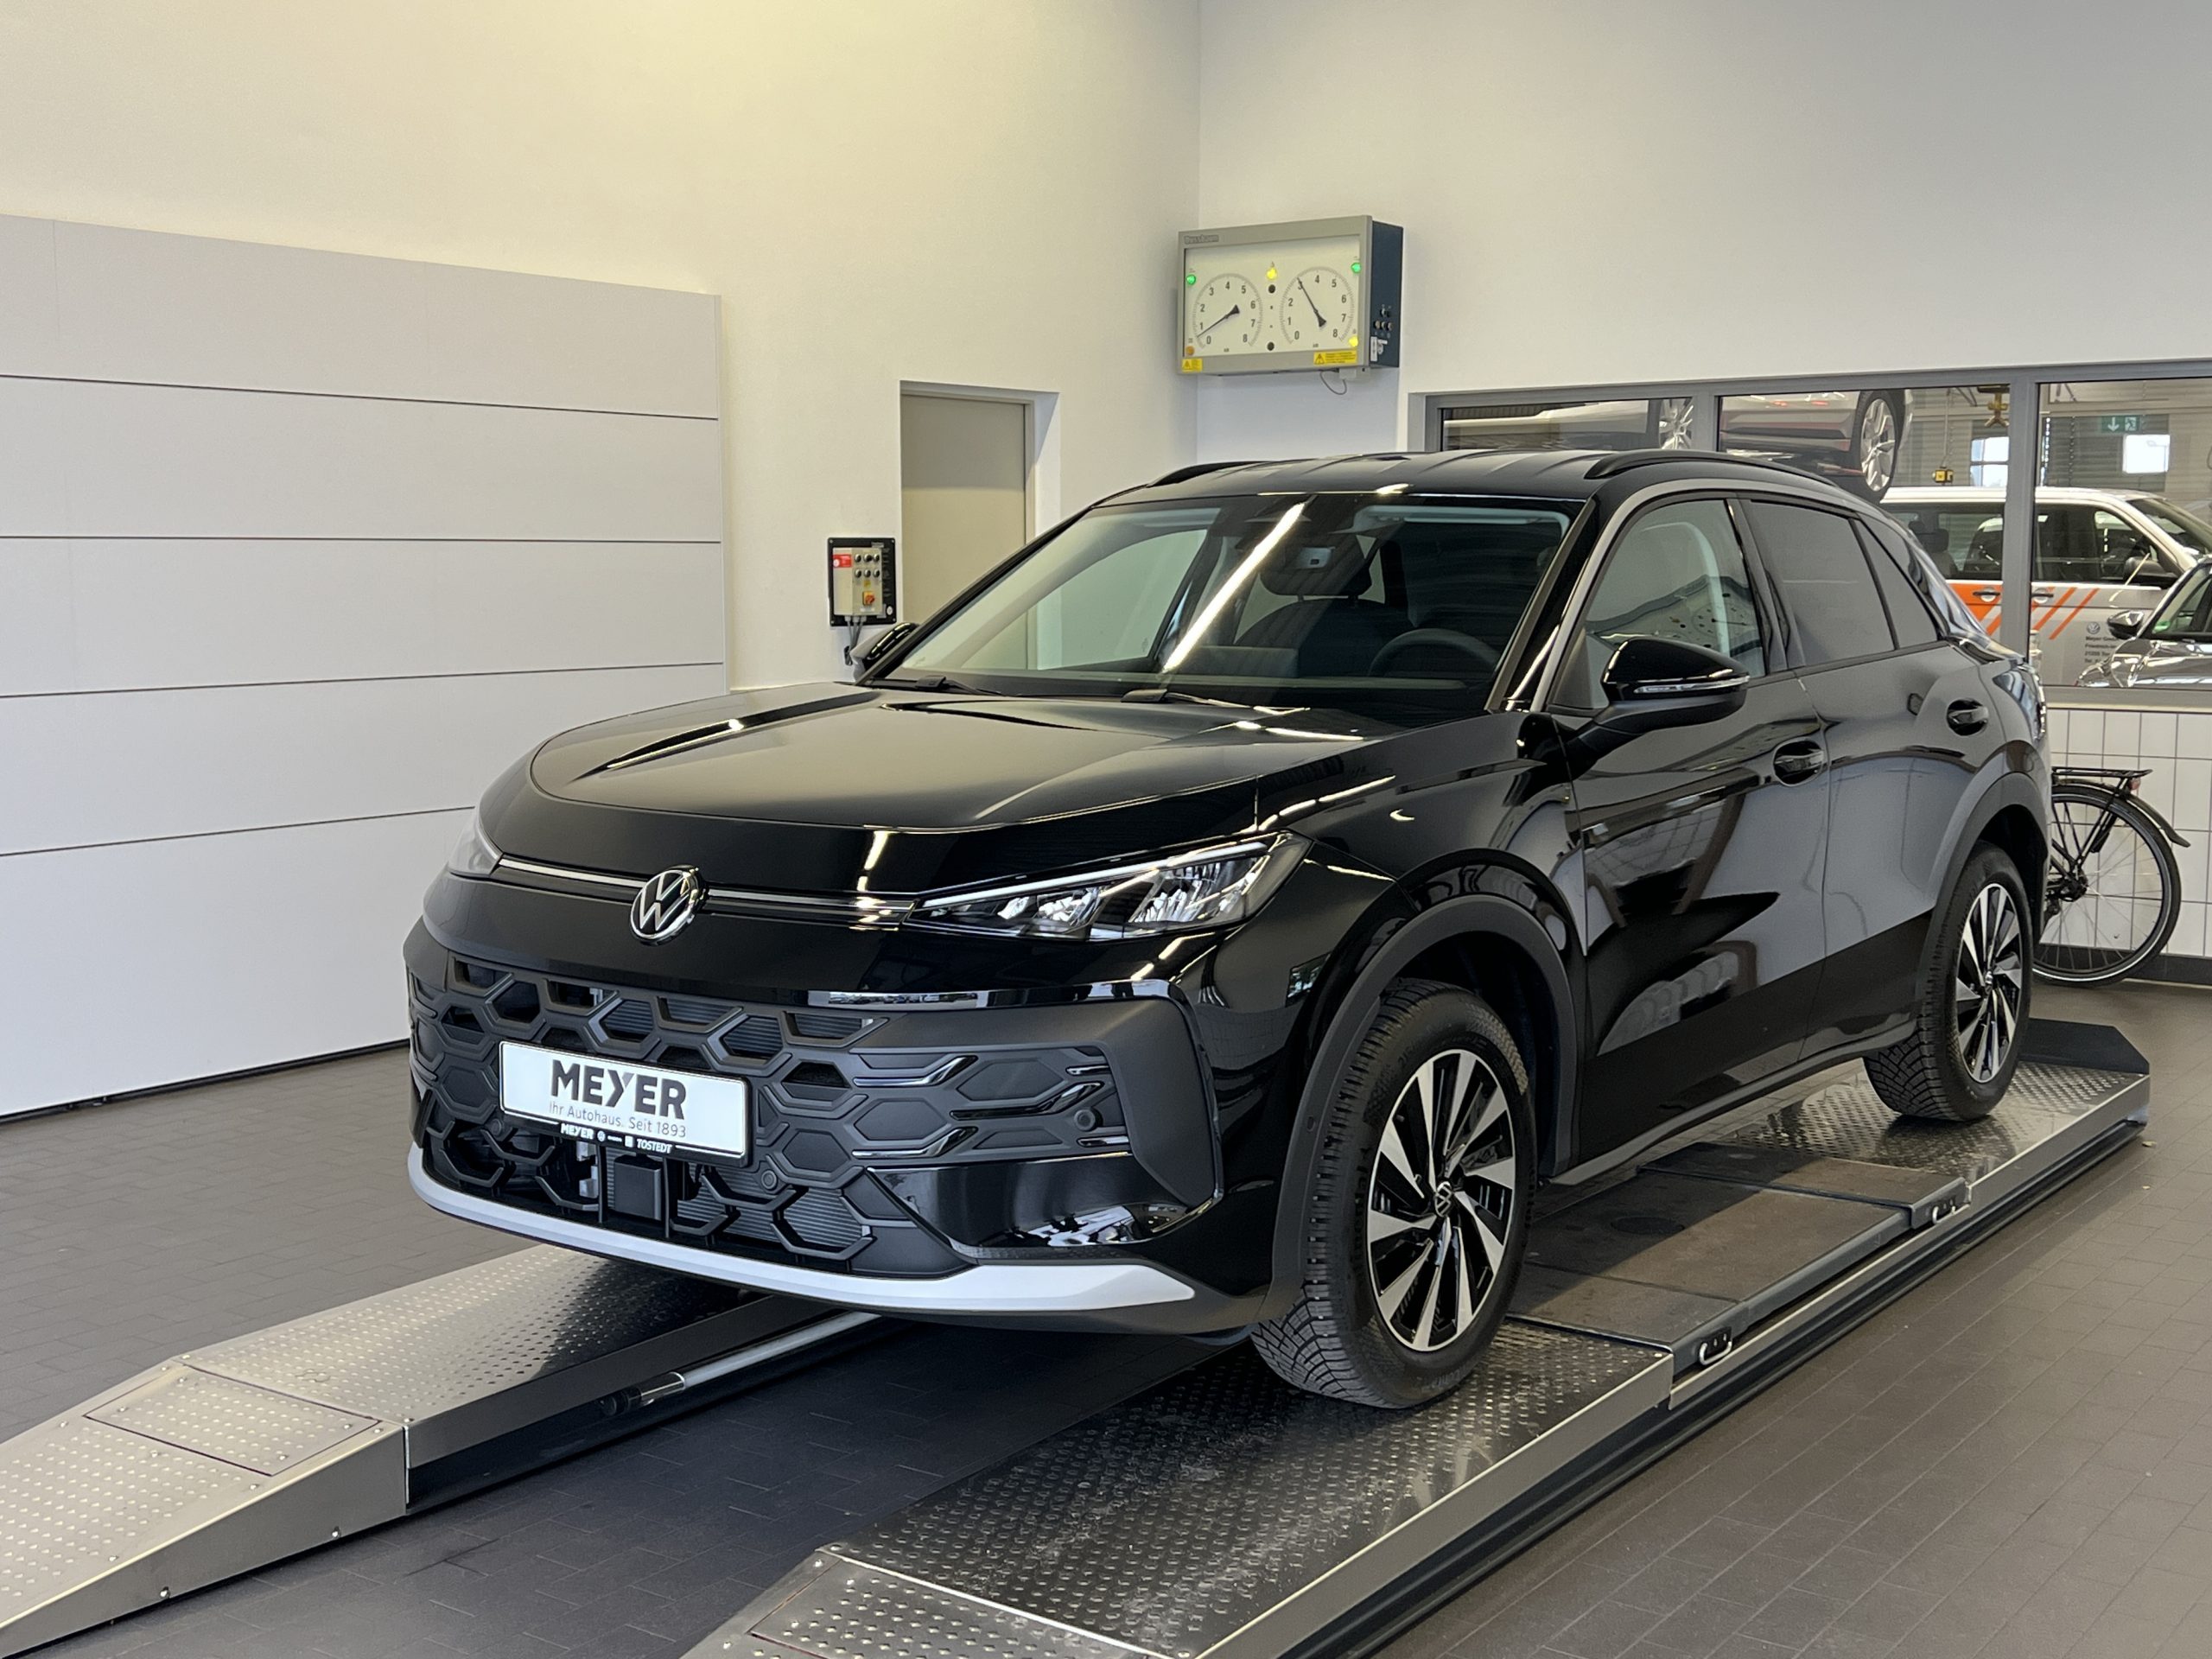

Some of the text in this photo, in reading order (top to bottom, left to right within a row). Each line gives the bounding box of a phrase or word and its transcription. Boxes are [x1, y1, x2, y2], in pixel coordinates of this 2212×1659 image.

[1315, 275, 1319, 283] 4
[1332, 279, 1337, 288] 5
[1225, 281, 1230, 289] 4
[1241, 285, 1246, 294] 5
[1209, 287, 1214, 296] 3
[1287, 298, 1294, 307] 2
[1341, 295, 1346, 303] 6
[1250, 301, 1255, 309] 6
[1287, 316, 1291, 325] 1
[1341, 314, 1346, 322] 7
[1250, 319, 1255, 327] 7
[1294, 330, 1300, 340] 0
[1332, 328, 1338, 338] 8
[1206, 335, 1211, 344] 0
[1243, 334, 1248, 342] 8
[550, 1059, 687, 1120] MEYER
[549, 1100, 686, 1138] Ihr Autohaus. Seit 1893
[560, 1123, 594, 1140] MEYER
[637, 1138, 672, 1154] TOSTEDT
